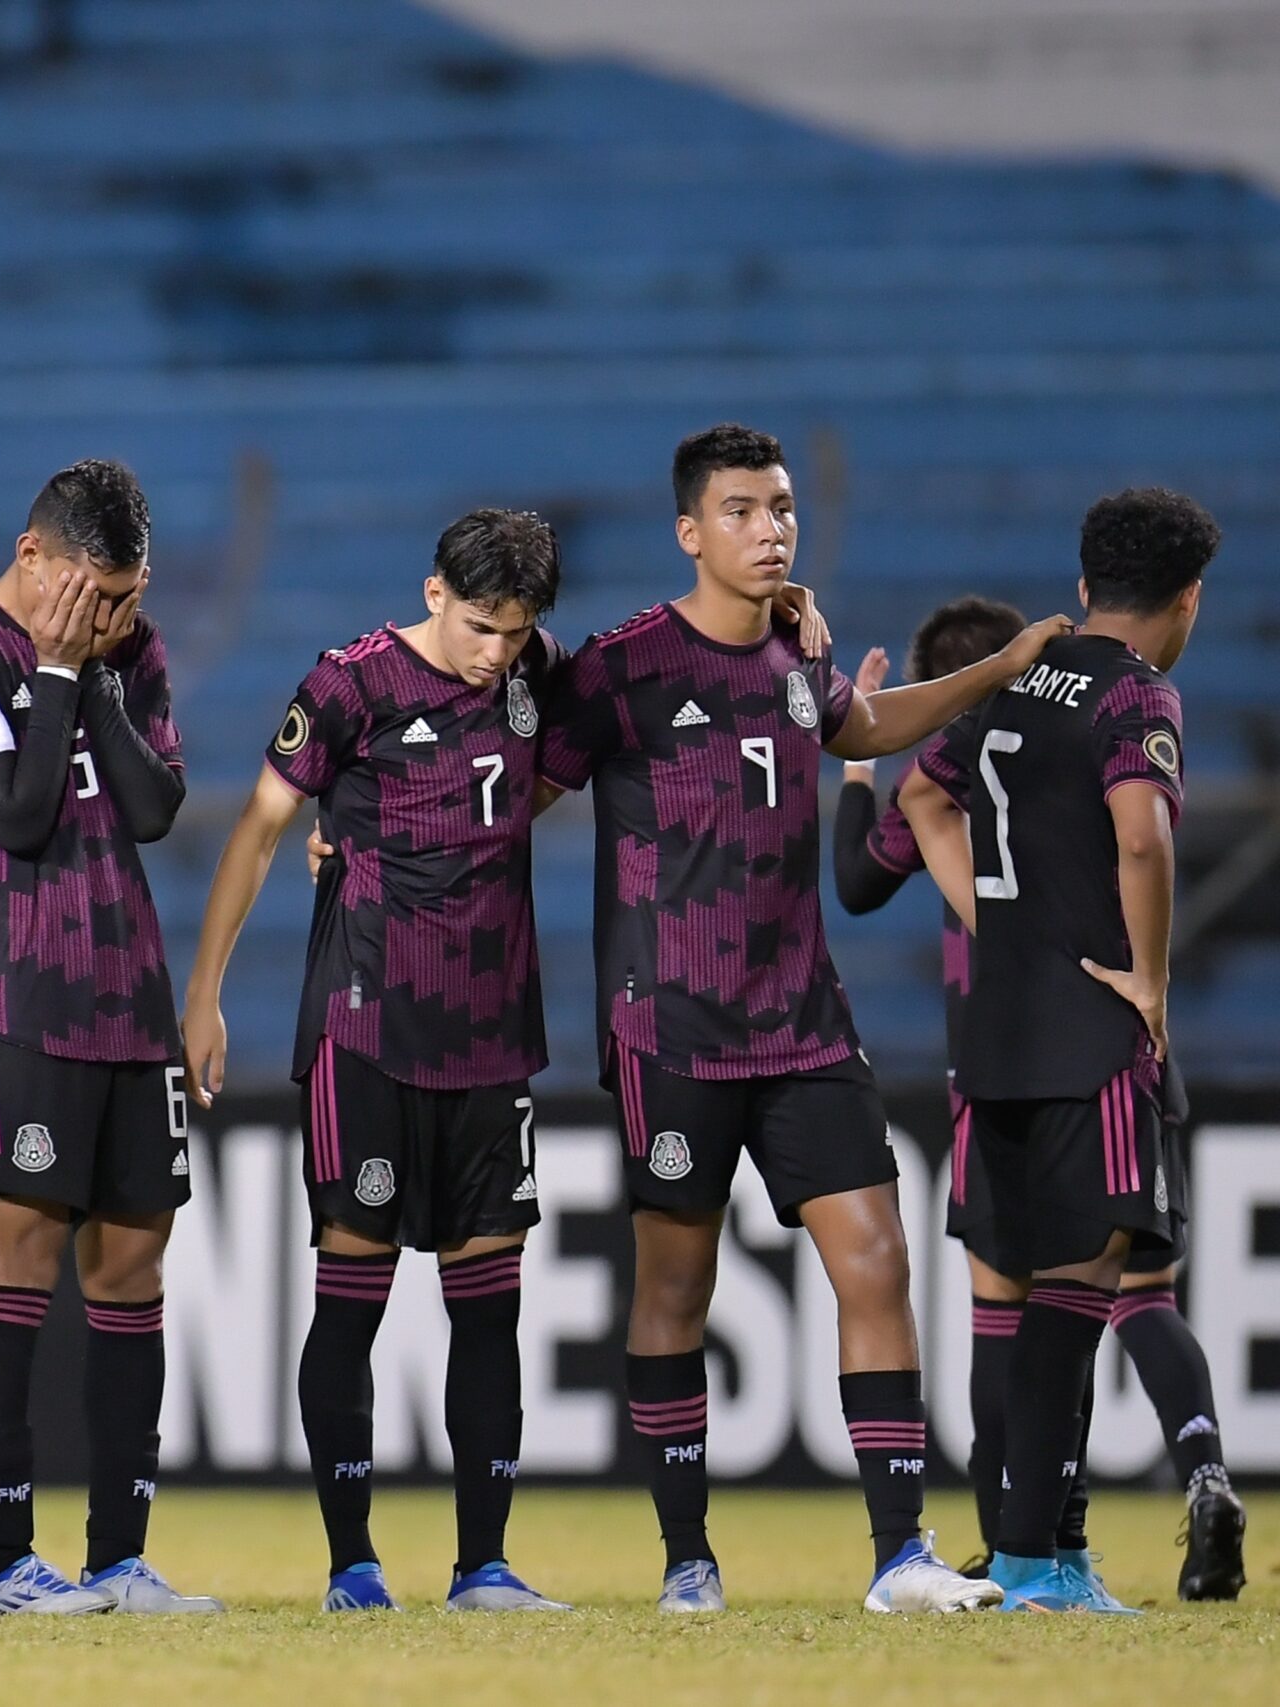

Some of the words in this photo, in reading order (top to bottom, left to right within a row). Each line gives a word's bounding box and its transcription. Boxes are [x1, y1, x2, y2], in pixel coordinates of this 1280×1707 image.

[401, 732, 439, 744] adidas
[672, 713, 711, 727] adidas
[472, 753, 504, 827] 7
[740, 736, 777, 808] 9
[976, 728, 1024, 900] 5
[165, 1066, 188, 1138] 6
[514, 1097, 534, 1168] 7
[335, 1460, 372, 1480] FMF
[665, 1444, 704, 1464] FMF
[889, 1459, 925, 1475] FMF
